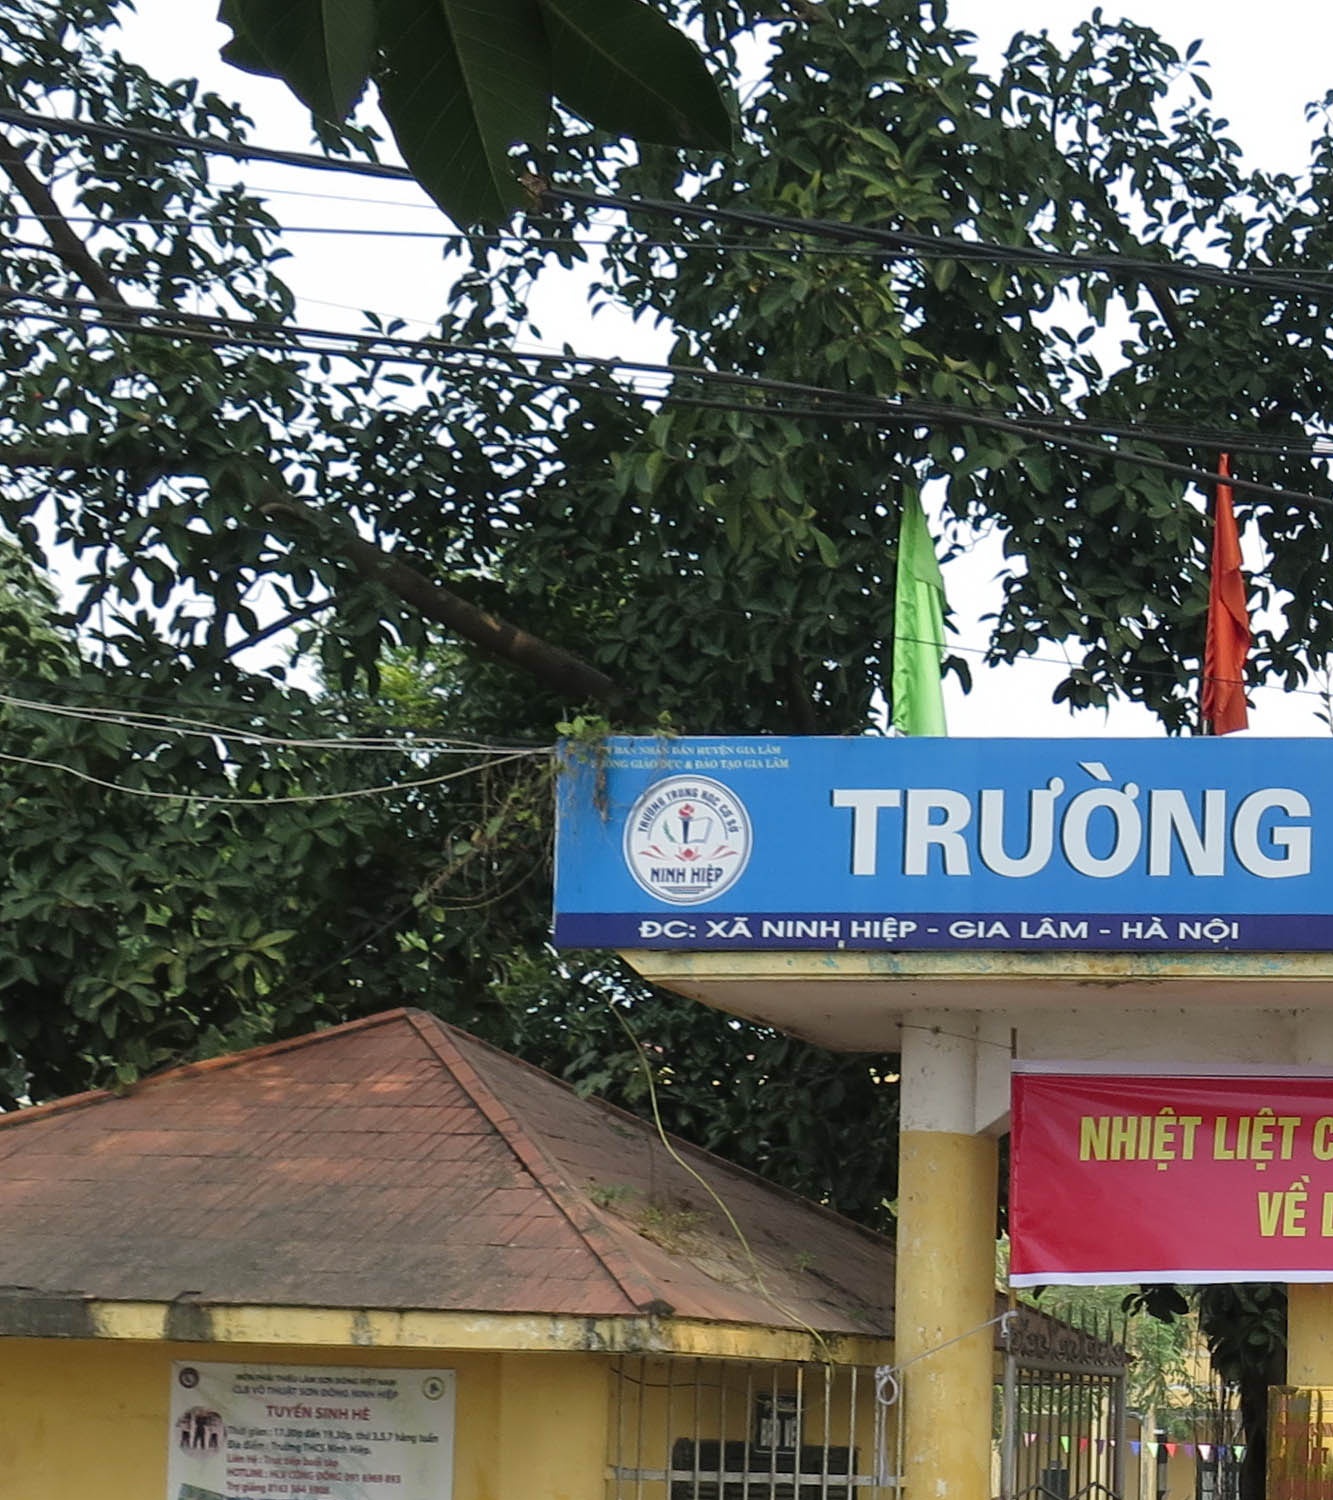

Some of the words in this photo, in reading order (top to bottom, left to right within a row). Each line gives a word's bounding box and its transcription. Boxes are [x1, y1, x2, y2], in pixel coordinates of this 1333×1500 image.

[833, 761, 1312, 878] TRƯỜNG
[650, 867, 686, 884] NINH
[638, 919, 697, 940] ĐC:
[706, 916, 753, 940] XÃ
[762, 920, 842, 940] NINH
[850, 917, 918, 943] HIỆP
[949, 920, 1011, 940] GIA
[1020, 917, 1088, 940] LÂM
[1121, 916, 1169, 940] HÀ
[1178, 917, 1240, 945] NỘI
[1079, 1107, 1202, 1170] NHIỆT
[1213, 1108, 1300, 1171] LIỆT
[1257, 1176, 1309, 1238] VỀ
[315, 1407, 349, 1420] SINH
